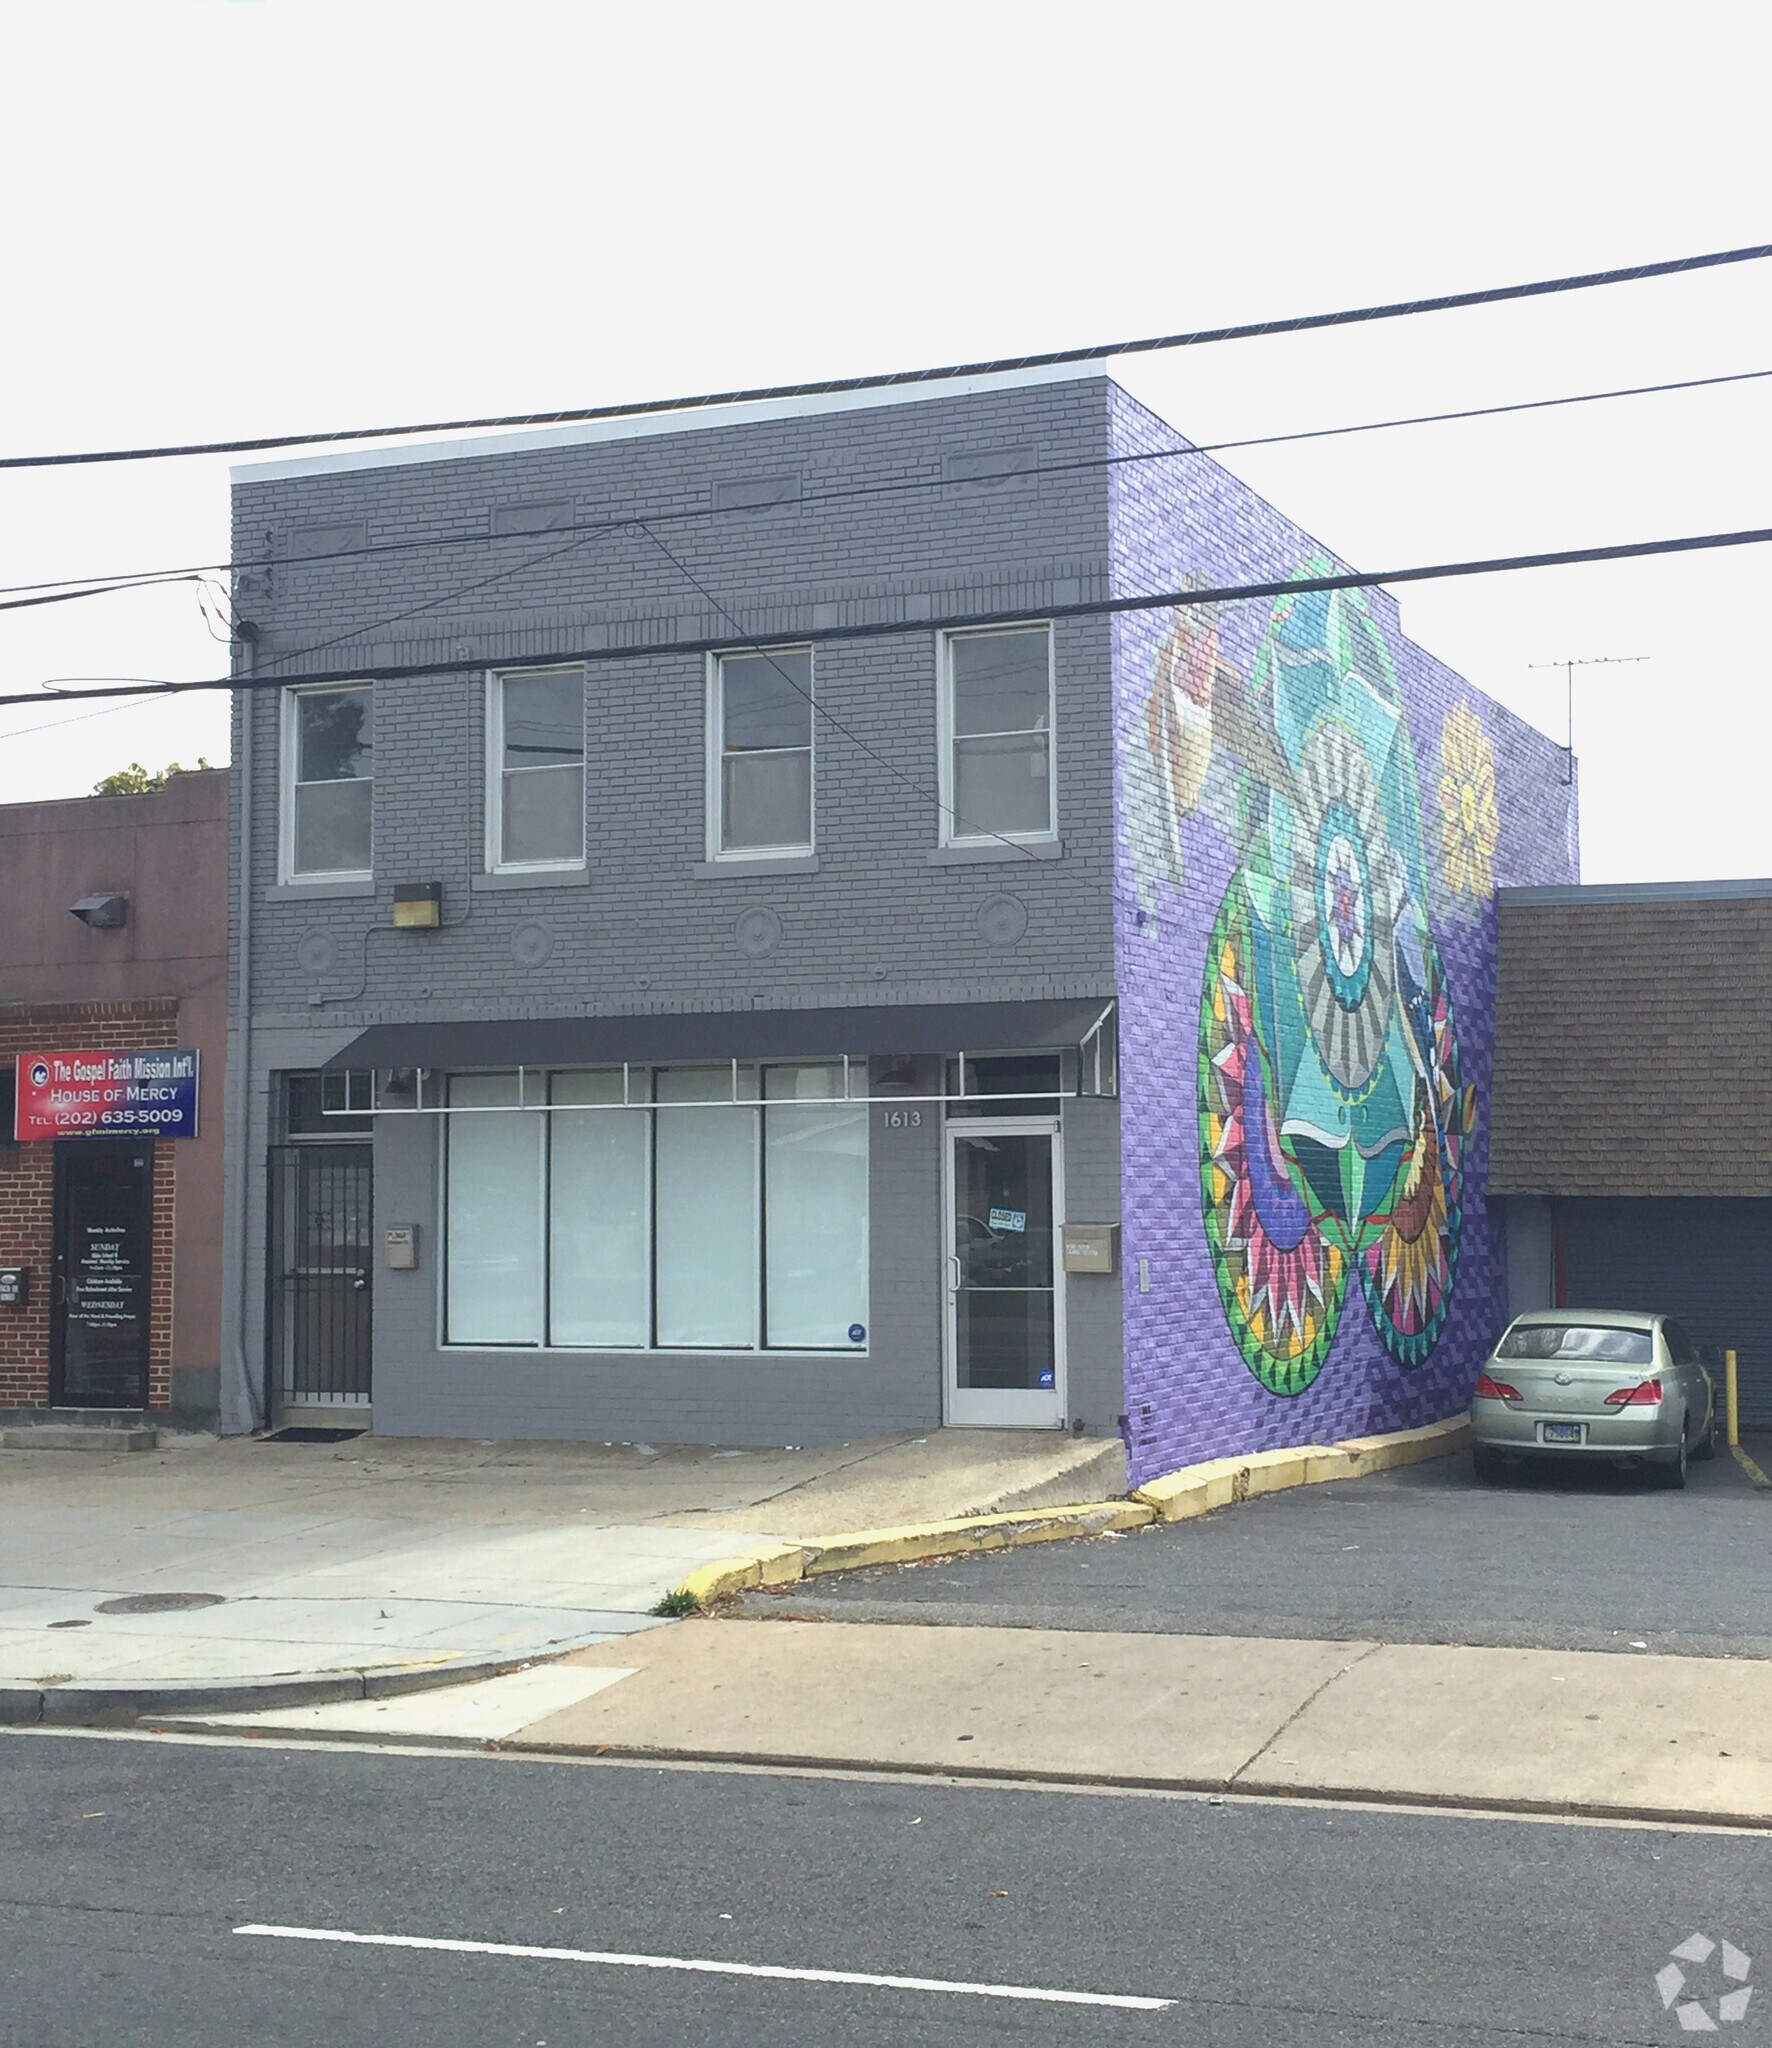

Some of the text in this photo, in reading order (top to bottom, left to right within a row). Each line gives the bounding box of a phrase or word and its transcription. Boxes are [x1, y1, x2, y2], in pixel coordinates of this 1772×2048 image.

[54, 1060, 71, 1082] The
[73, 1059, 106, 1086] Gospel
[108, 1058, 132, 1080] Faith
[134, 1057, 171, 1080] Mission
[50, 1087, 178, 1103] HOUSE OF MERCY
[55, 1111, 97, 1126] (202)
[101, 1109, 183, 1124] 635-5009
[884, 1111, 921, 1127] 1613
